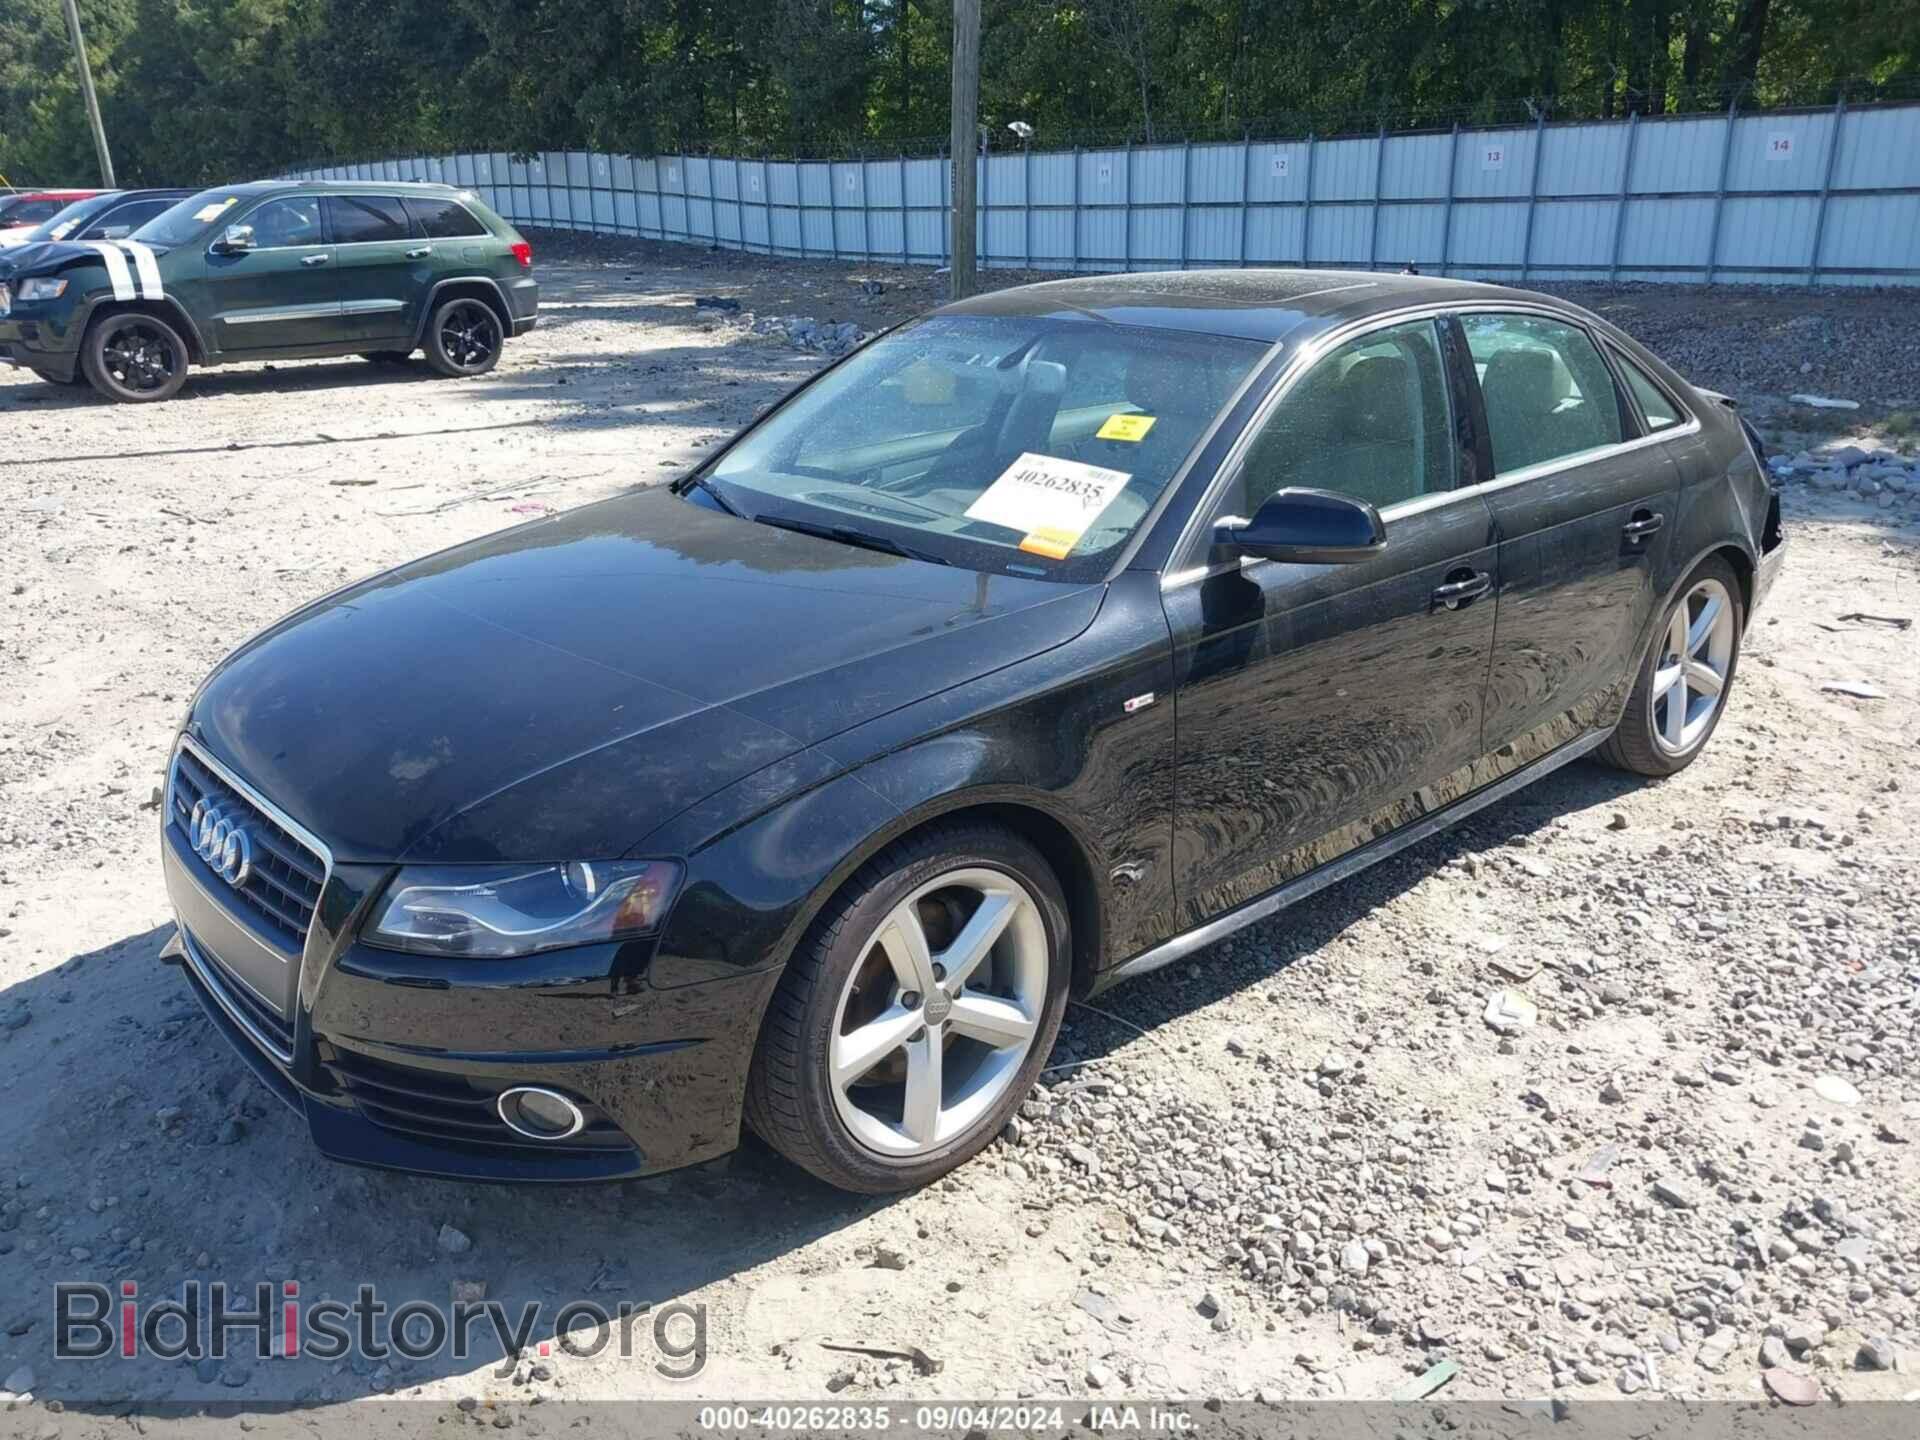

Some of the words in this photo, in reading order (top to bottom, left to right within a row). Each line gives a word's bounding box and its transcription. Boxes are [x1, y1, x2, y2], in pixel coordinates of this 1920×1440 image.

[1773, 140, 1789, 151] 14
[1488, 152, 1500, 161] 13
[1275, 160, 1286, 169] 12
[1015, 469, 1105, 498] 40262835
